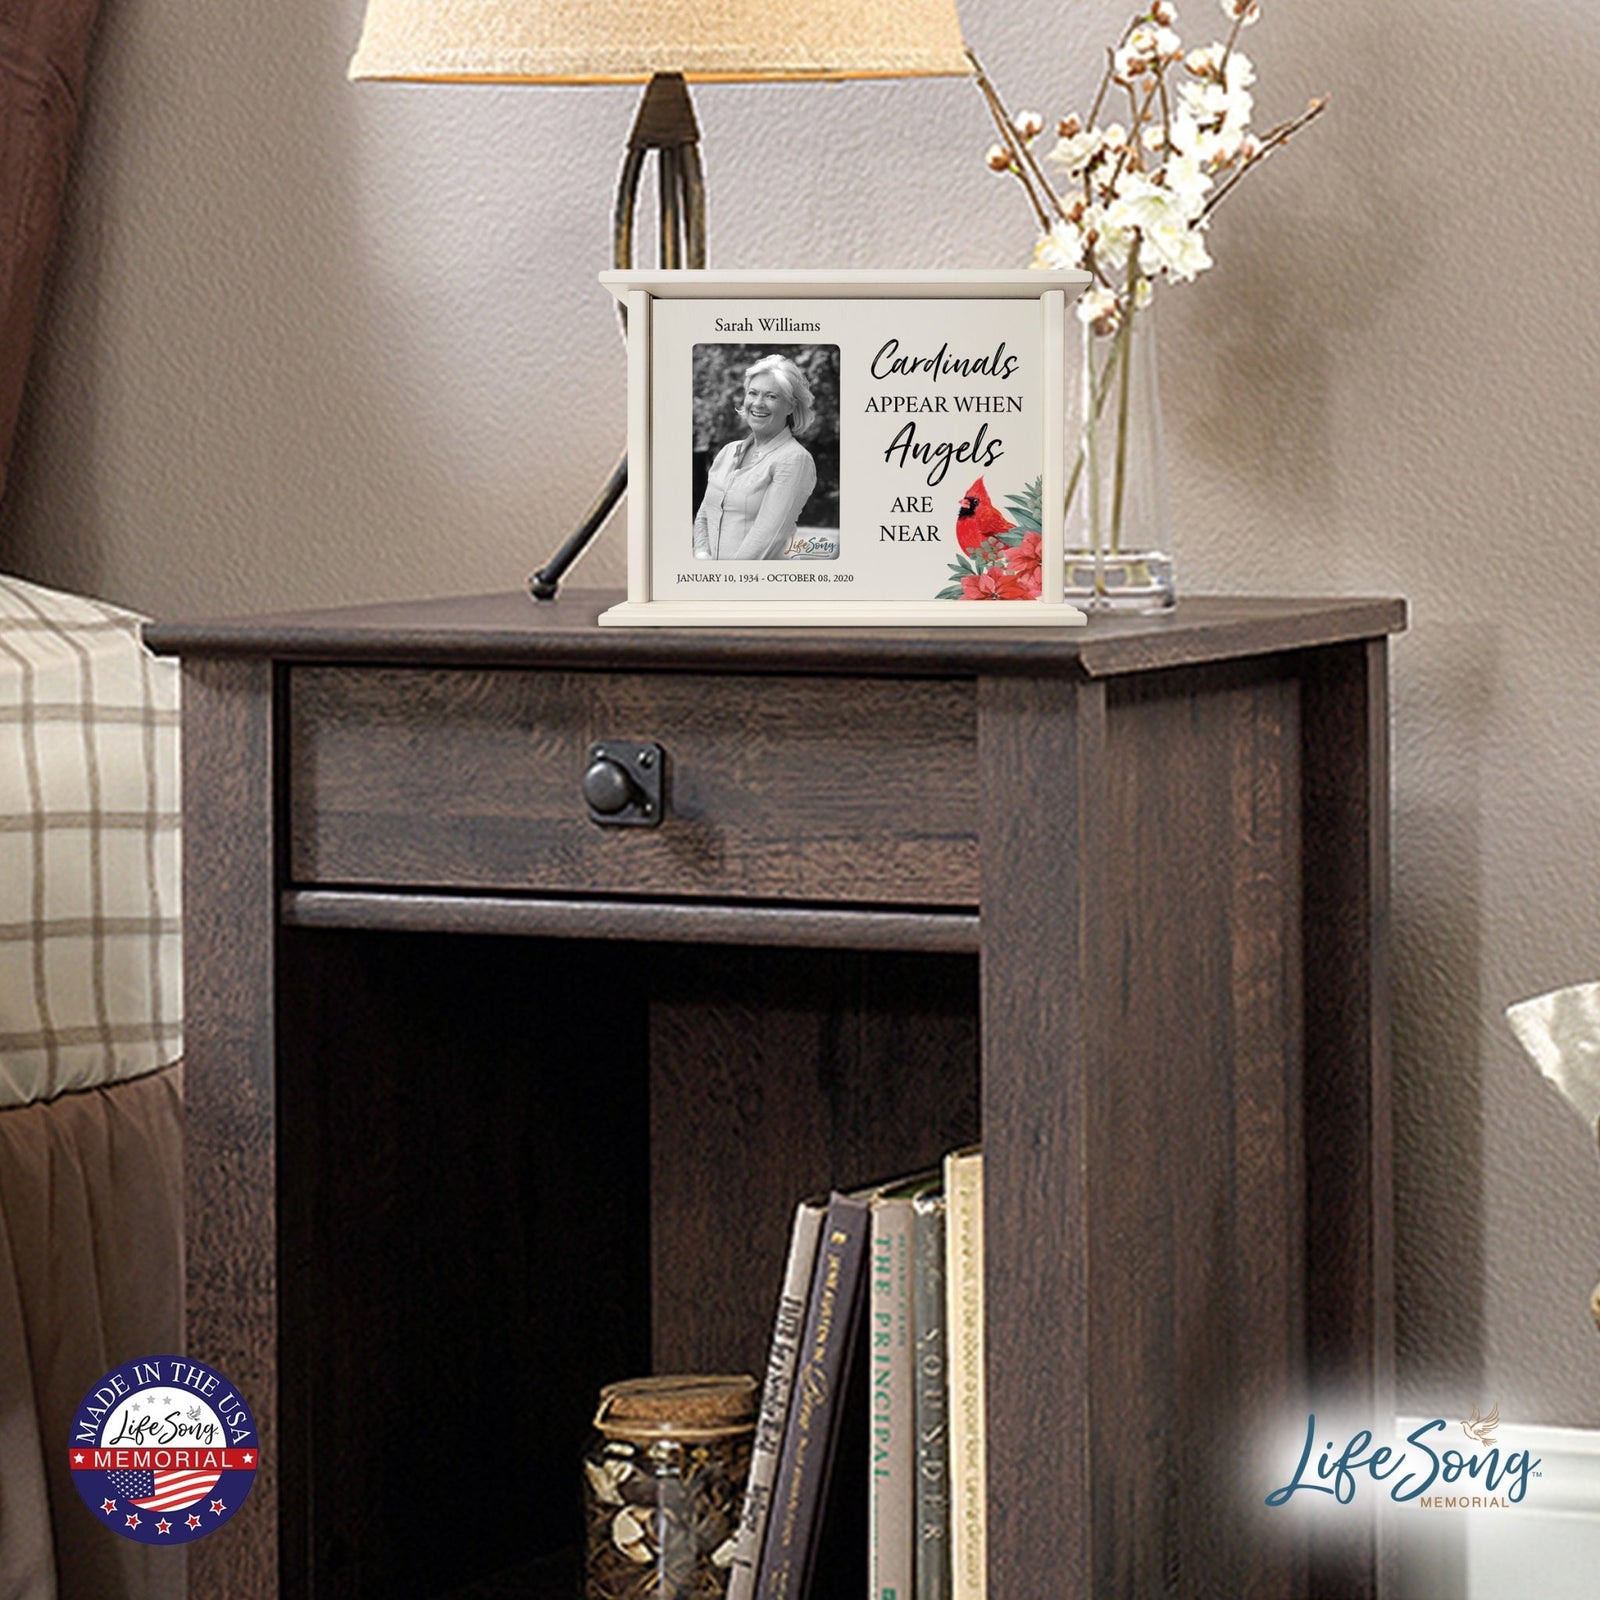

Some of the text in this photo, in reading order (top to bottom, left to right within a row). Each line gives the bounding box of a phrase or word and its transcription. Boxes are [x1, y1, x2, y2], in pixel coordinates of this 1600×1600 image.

[714, 317, 821, 332] Sarah Williams
[870, 338, 1019, 382] Cardinals
[864, 396, 1023, 413] APPEAR WHEN
[884, 421, 1004, 487] Angels
[890, 496, 934, 513] ARE
[879, 525, 942, 542] NEAR
[676, 573, 722, 584] JANUARY
[723, 574, 736, 583] 10,
[739, 573, 759, 583] 1934
[766, 573, 816, 583] OCTOBER
[817, 574, 831, 583] 08,
[833, 574, 854, 583] 2020
[873, 1234, 892, 1484] THE PRINCIPAL
